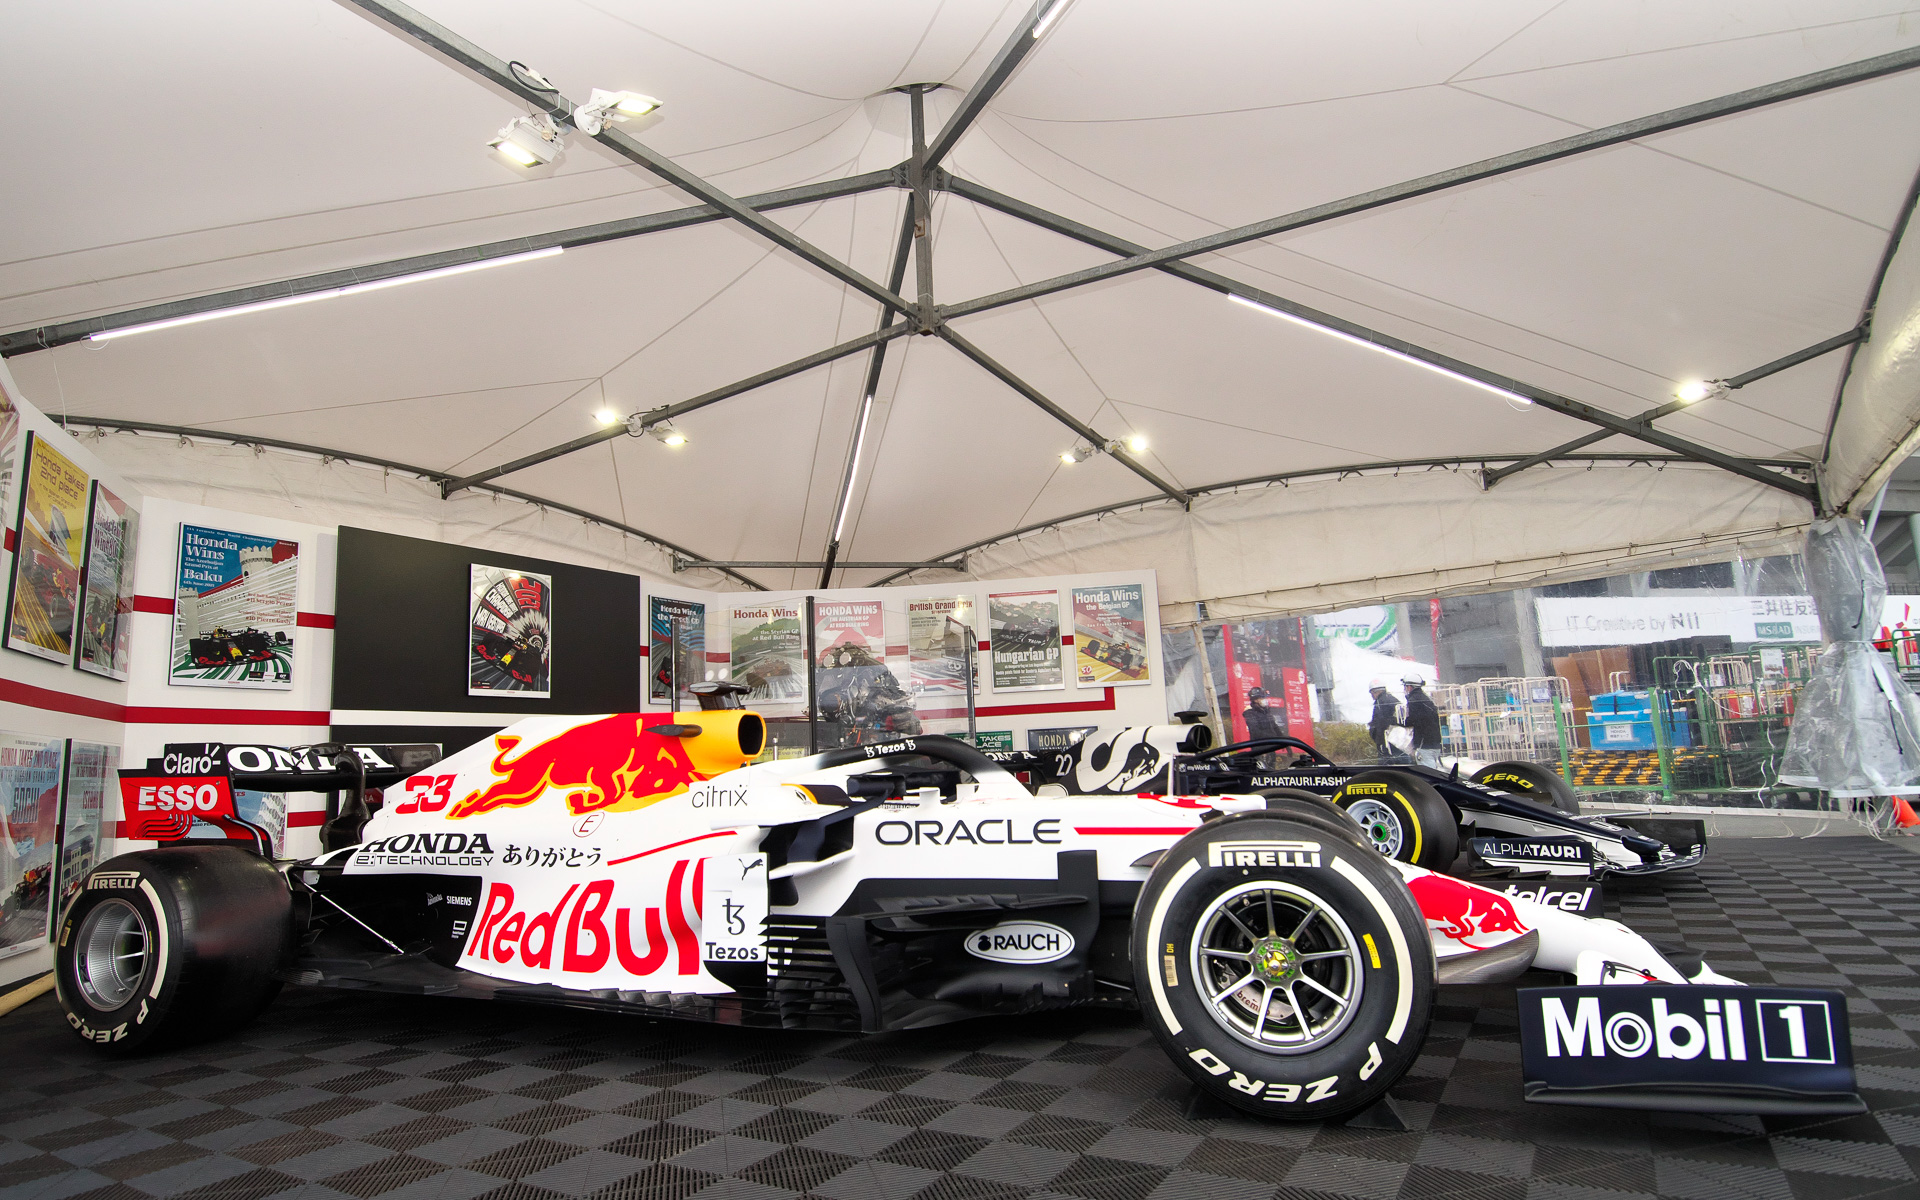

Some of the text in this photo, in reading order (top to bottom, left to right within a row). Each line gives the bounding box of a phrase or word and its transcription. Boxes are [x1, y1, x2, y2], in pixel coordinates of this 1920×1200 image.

[36, 448, 62, 476] Honda
[64, 469, 86, 493] takes
[40, 465, 58, 486] 2nd
[58, 480, 79, 501] place
[185, 532, 238, 551] Honda
[185, 544, 225, 560] Wins
[183, 568, 223, 583] Baku
[1075, 590, 1111, 604] Honda
[1111, 588, 1140, 601] Wins
[1098, 602, 1122, 610] Belgian
[1121, 601, 1131, 609] GP
[660, 604, 681, 615] Honda
[733, 608, 798, 619] Honda Wins
[818, 604, 878, 617] HONDA WINS
[909, 601, 933, 612] British
[934, 600, 956, 610] Grand
[1649, 615, 1666, 633] by
[1757, 625, 1791, 635] MS&AD
[994, 646, 1060, 665] Hungarian GP
[875, 742, 906, 755] Tezos
[1038, 733, 1068, 747] HONDA
[163, 752, 212, 775] Claro
[1250, 776, 1353, 787] ALPHATAURI.FASHI
[1346, 782, 1388, 796] PIRELLI
[1482, 772, 1535, 789] ZERO
[137, 783, 219, 812] ESSO
[395, 773, 459, 815] 33
[690, 784, 748, 809] citrix
[11, 786, 40, 824] SOCHI
[874, 818, 1063, 846] ORACLE
[358, 832, 494, 855] HONDA
[1482, 842, 1582, 859] ALPHATAURI
[502, 843, 602, 870] ありがとう
[1208, 840, 1322, 868] PIRELLI
[86, 871, 141, 890] PIRELLI
[446, 895, 473, 907] SIEMENS
[1502, 884, 1595, 911] telcel
[468, 881, 581, 970] Red
[705, 941, 760, 962] Tezos
[994, 932, 1060, 952] RAUCH
[1236, 990, 1271, 1017] bremo
[66, 998, 149, 1043] P ZERO
[1541, 996, 1810, 1061] Mobil 1
[1188, 1041, 1384, 1104] P ZERO
